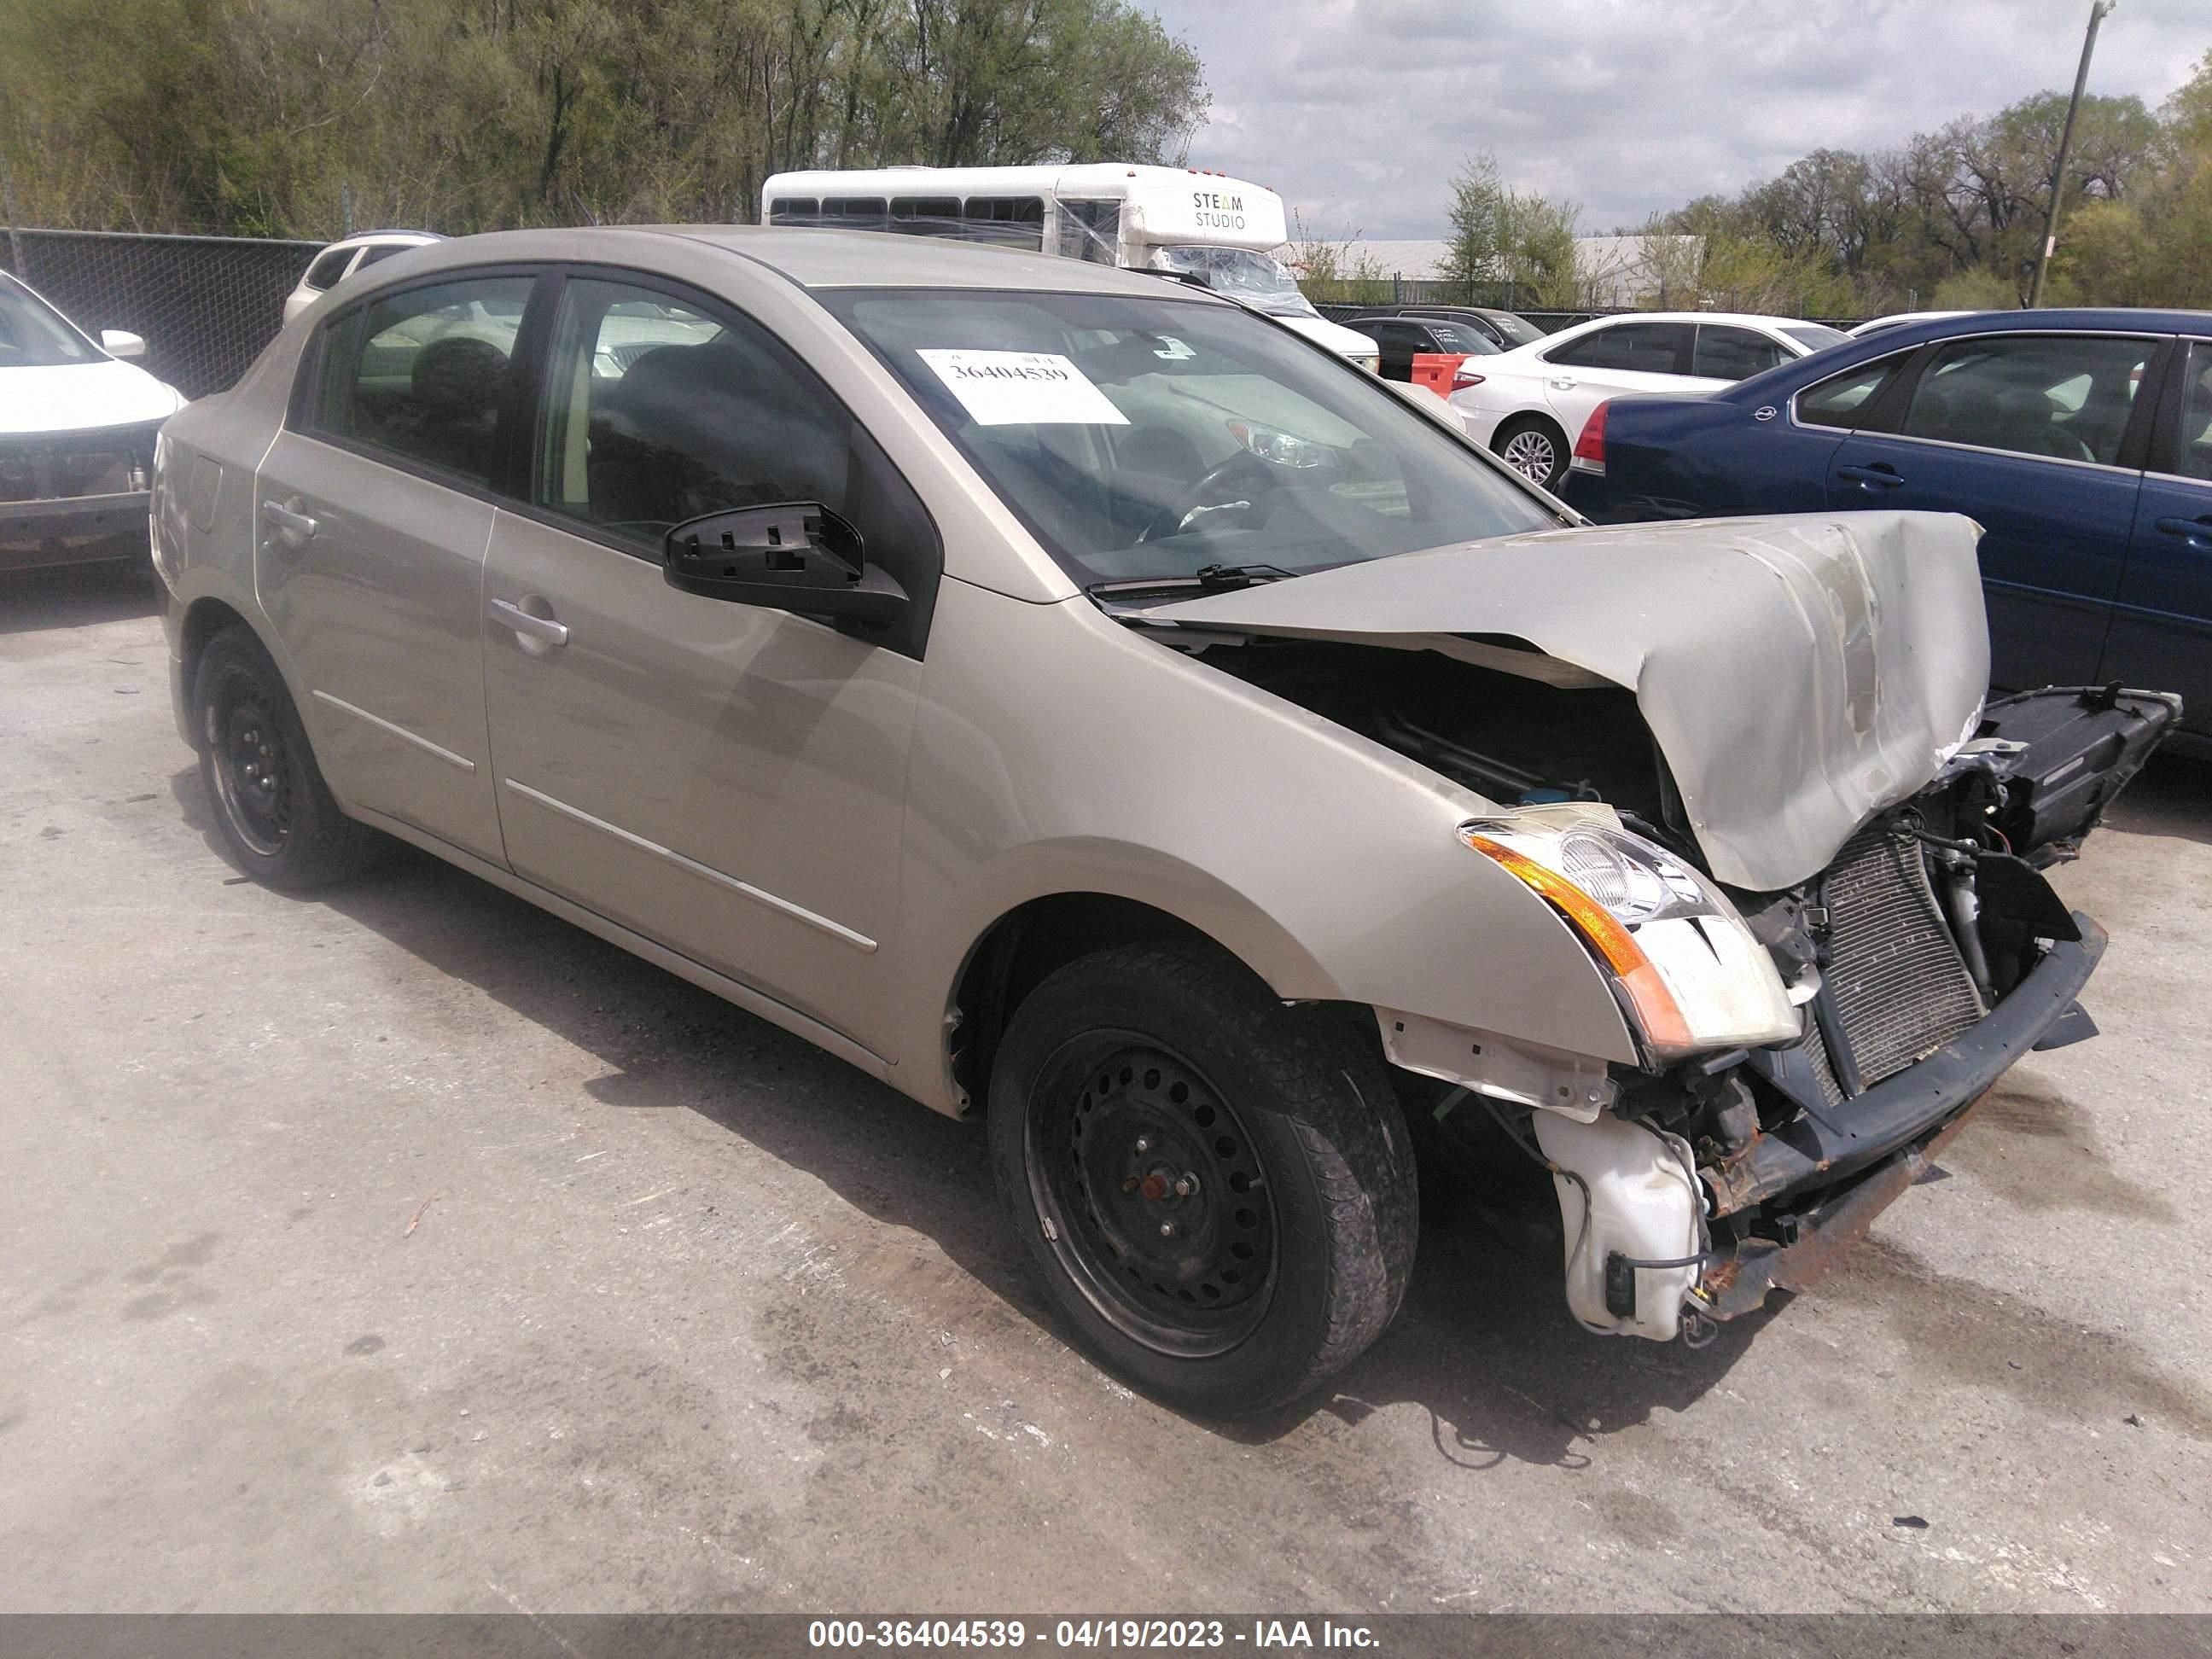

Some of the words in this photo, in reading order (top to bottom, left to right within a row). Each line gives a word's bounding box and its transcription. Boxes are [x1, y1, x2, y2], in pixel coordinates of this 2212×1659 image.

[1194, 193, 1243, 212] STEAM
[1196, 212, 1244, 229] STUDIO
[950, 365, 1068, 381] 36404539
